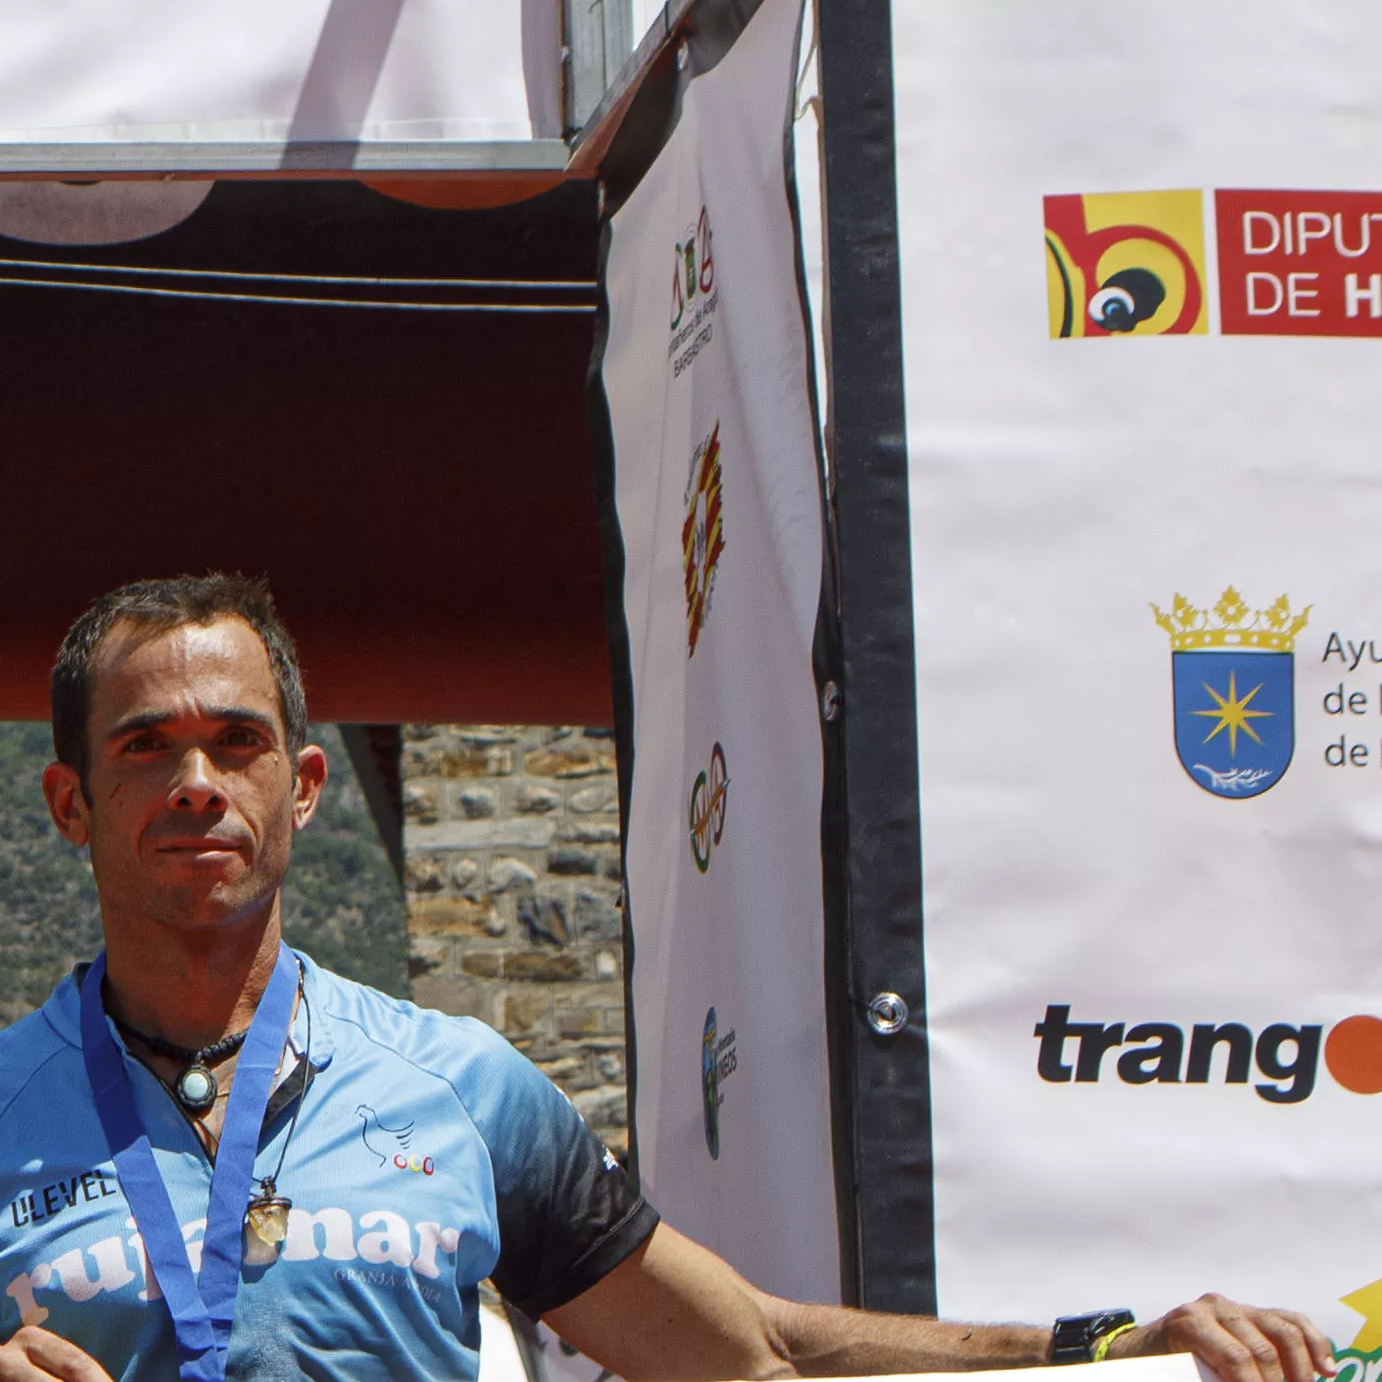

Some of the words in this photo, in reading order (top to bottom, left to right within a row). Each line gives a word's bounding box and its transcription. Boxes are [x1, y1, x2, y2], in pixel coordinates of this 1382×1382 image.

[1245, 271, 1321, 317] DE
[1323, 682, 1368, 715] de
[1325, 735, 1369, 767] de
